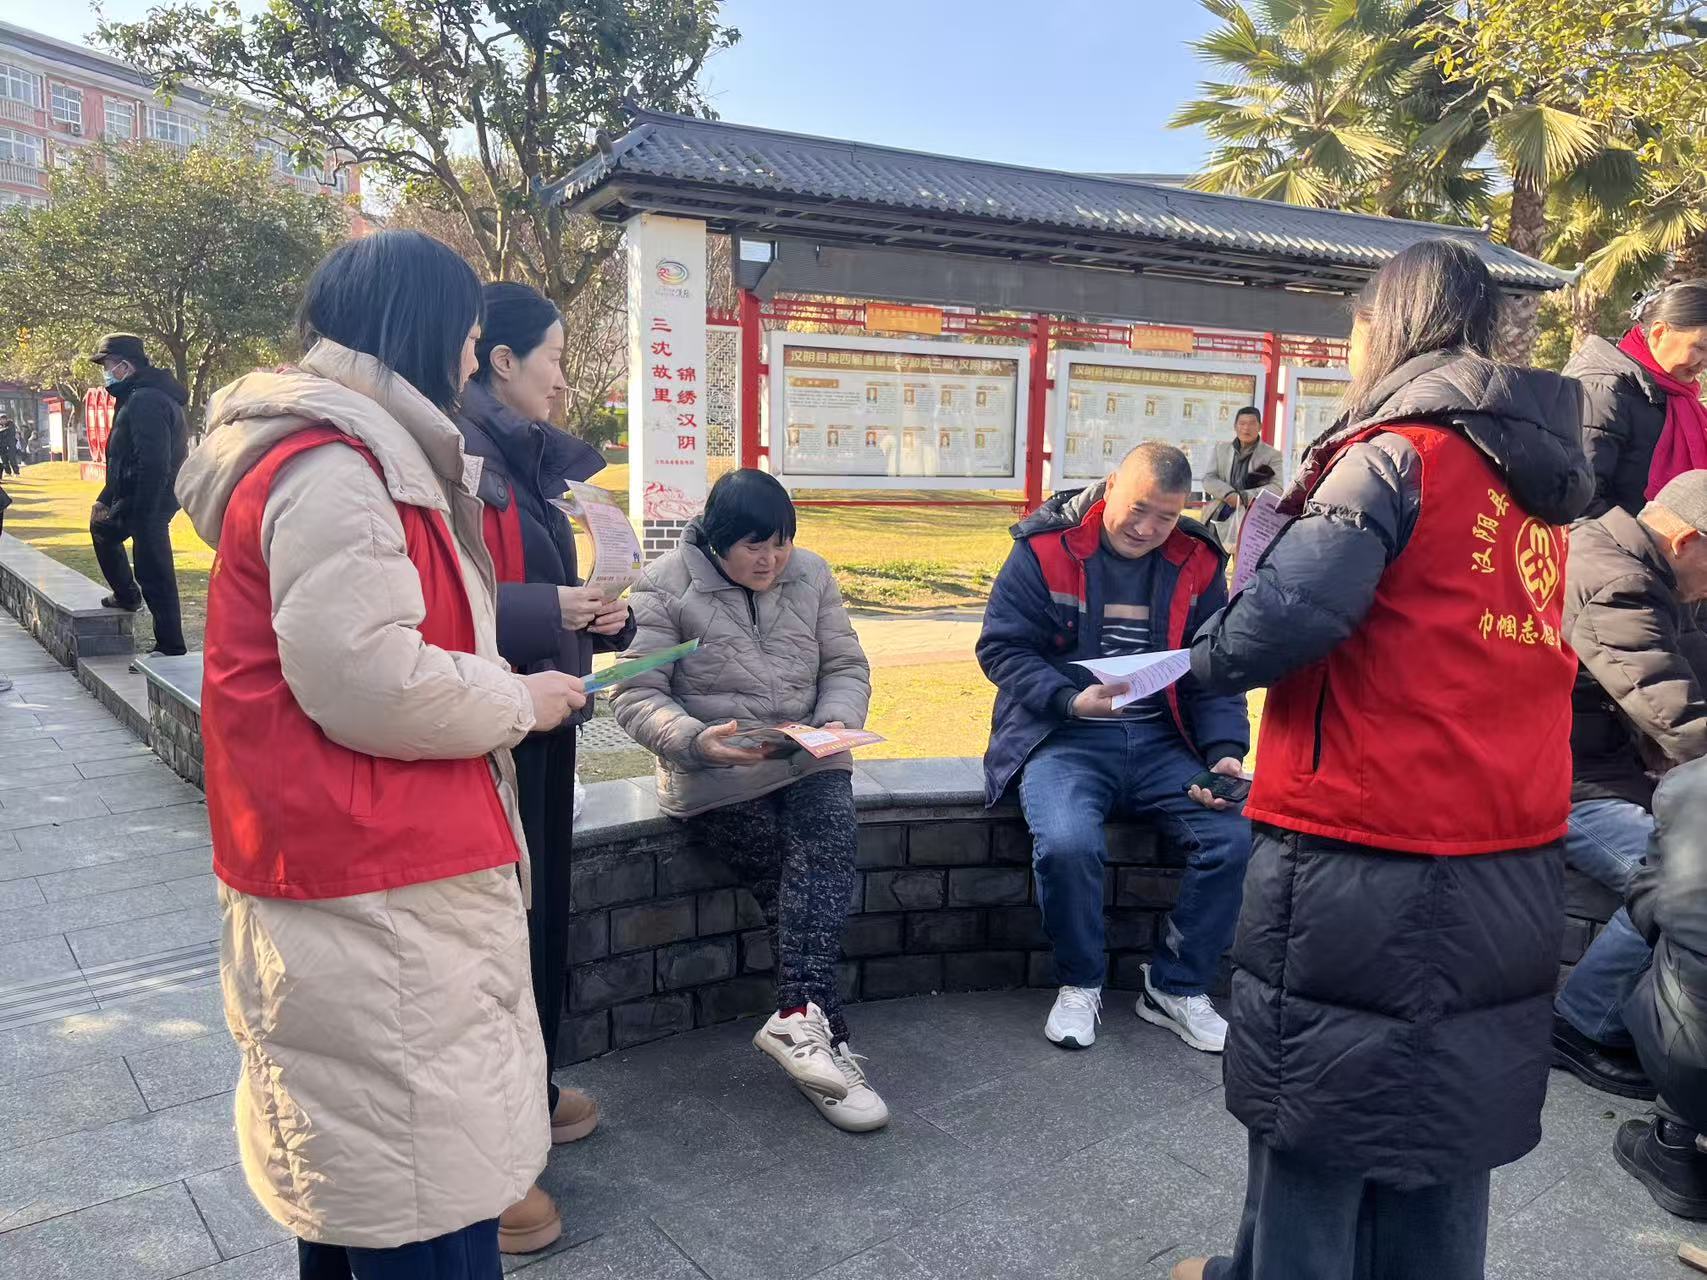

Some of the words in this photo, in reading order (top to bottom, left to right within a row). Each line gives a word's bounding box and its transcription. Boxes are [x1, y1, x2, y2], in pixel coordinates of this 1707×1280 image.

[651, 318, 672, 404] 三沈故里
[676, 366, 697, 450] 锦绣汉阴
[1478, 607, 1562, 650] 巾帼志愿
